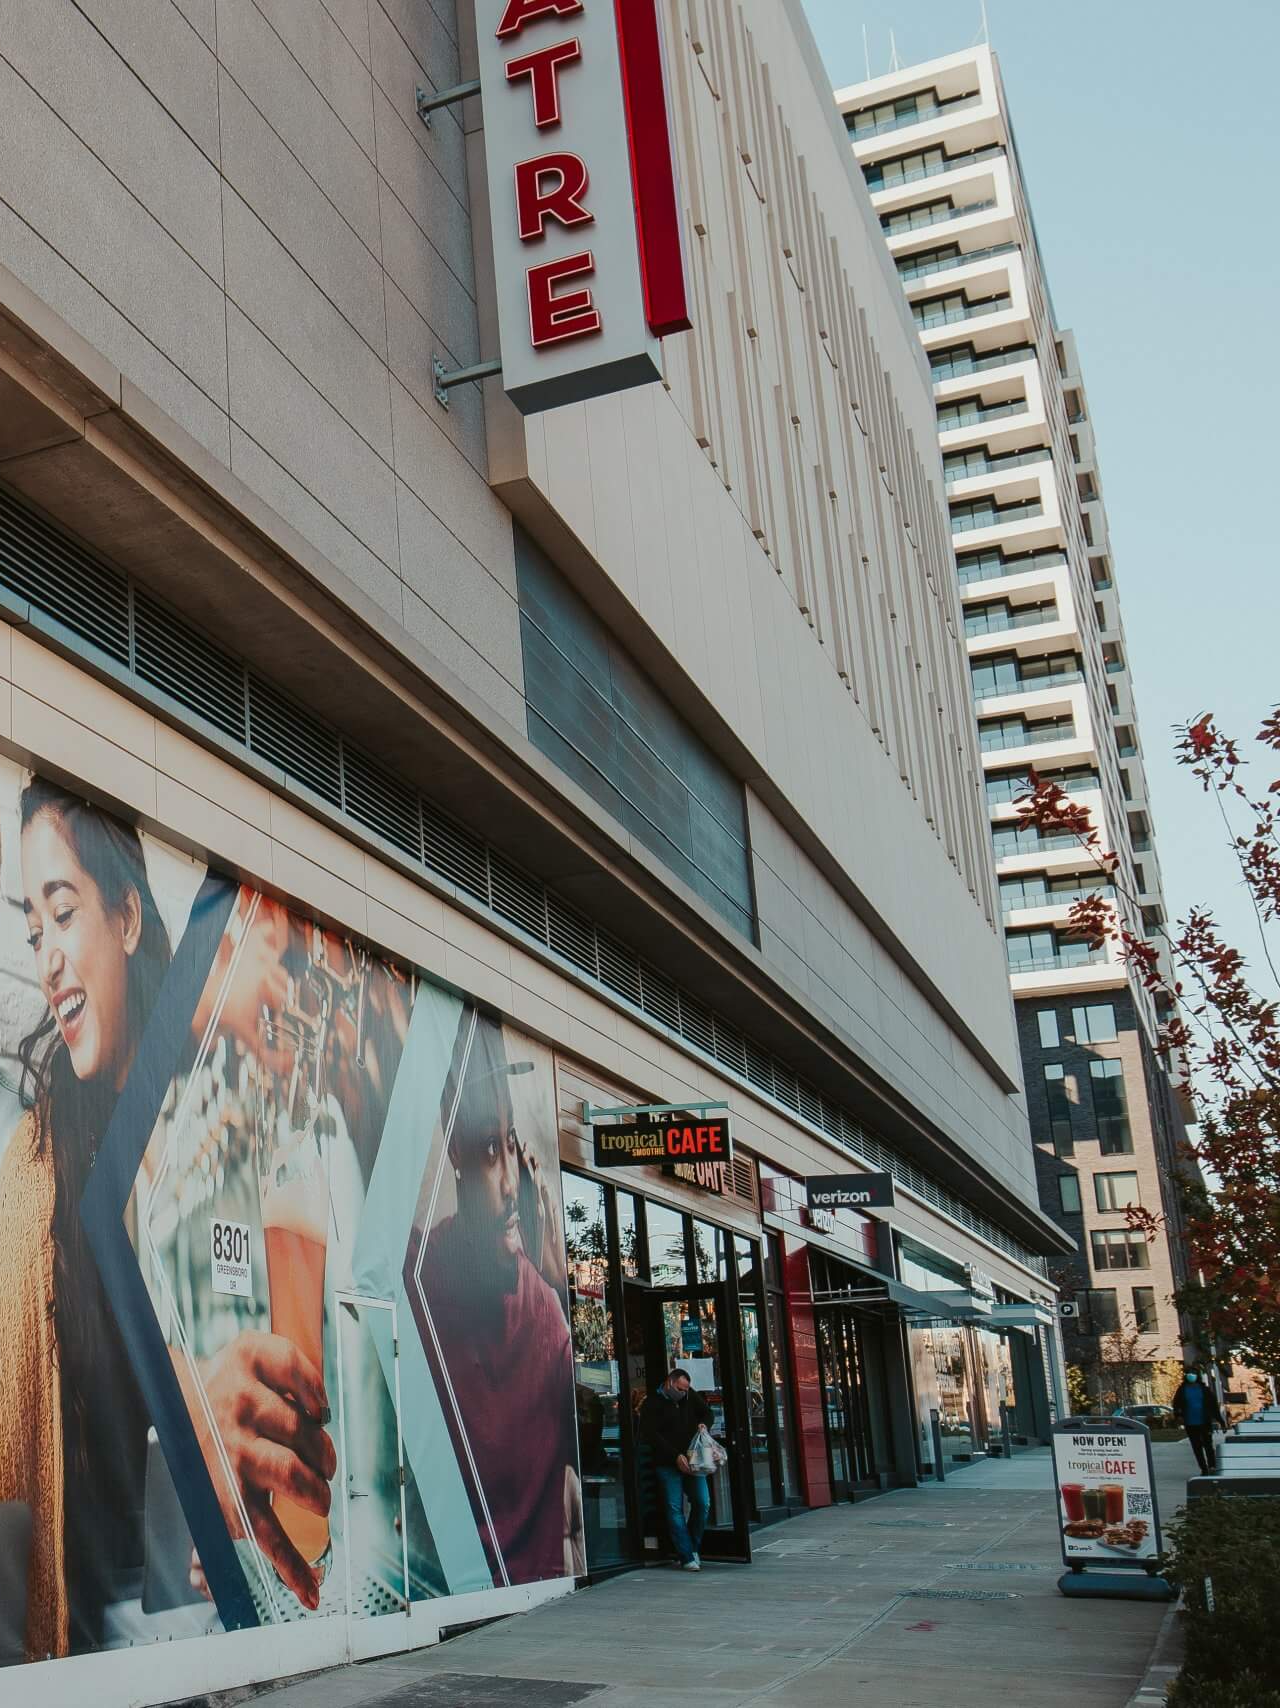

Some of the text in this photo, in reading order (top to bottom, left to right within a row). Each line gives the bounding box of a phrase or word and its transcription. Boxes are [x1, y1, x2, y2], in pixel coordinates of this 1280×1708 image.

[600, 1126, 723, 1155] tropical CAFE
[632, 1147, 666, 1157] SMOOTHIE
[811, 1189, 871, 1204] verizon
[213, 1223, 250, 1265] 8301
[1072, 1436, 1127, 1447] NOW OPEN!
[1068, 1460, 1136, 1475] tropical CAFE
